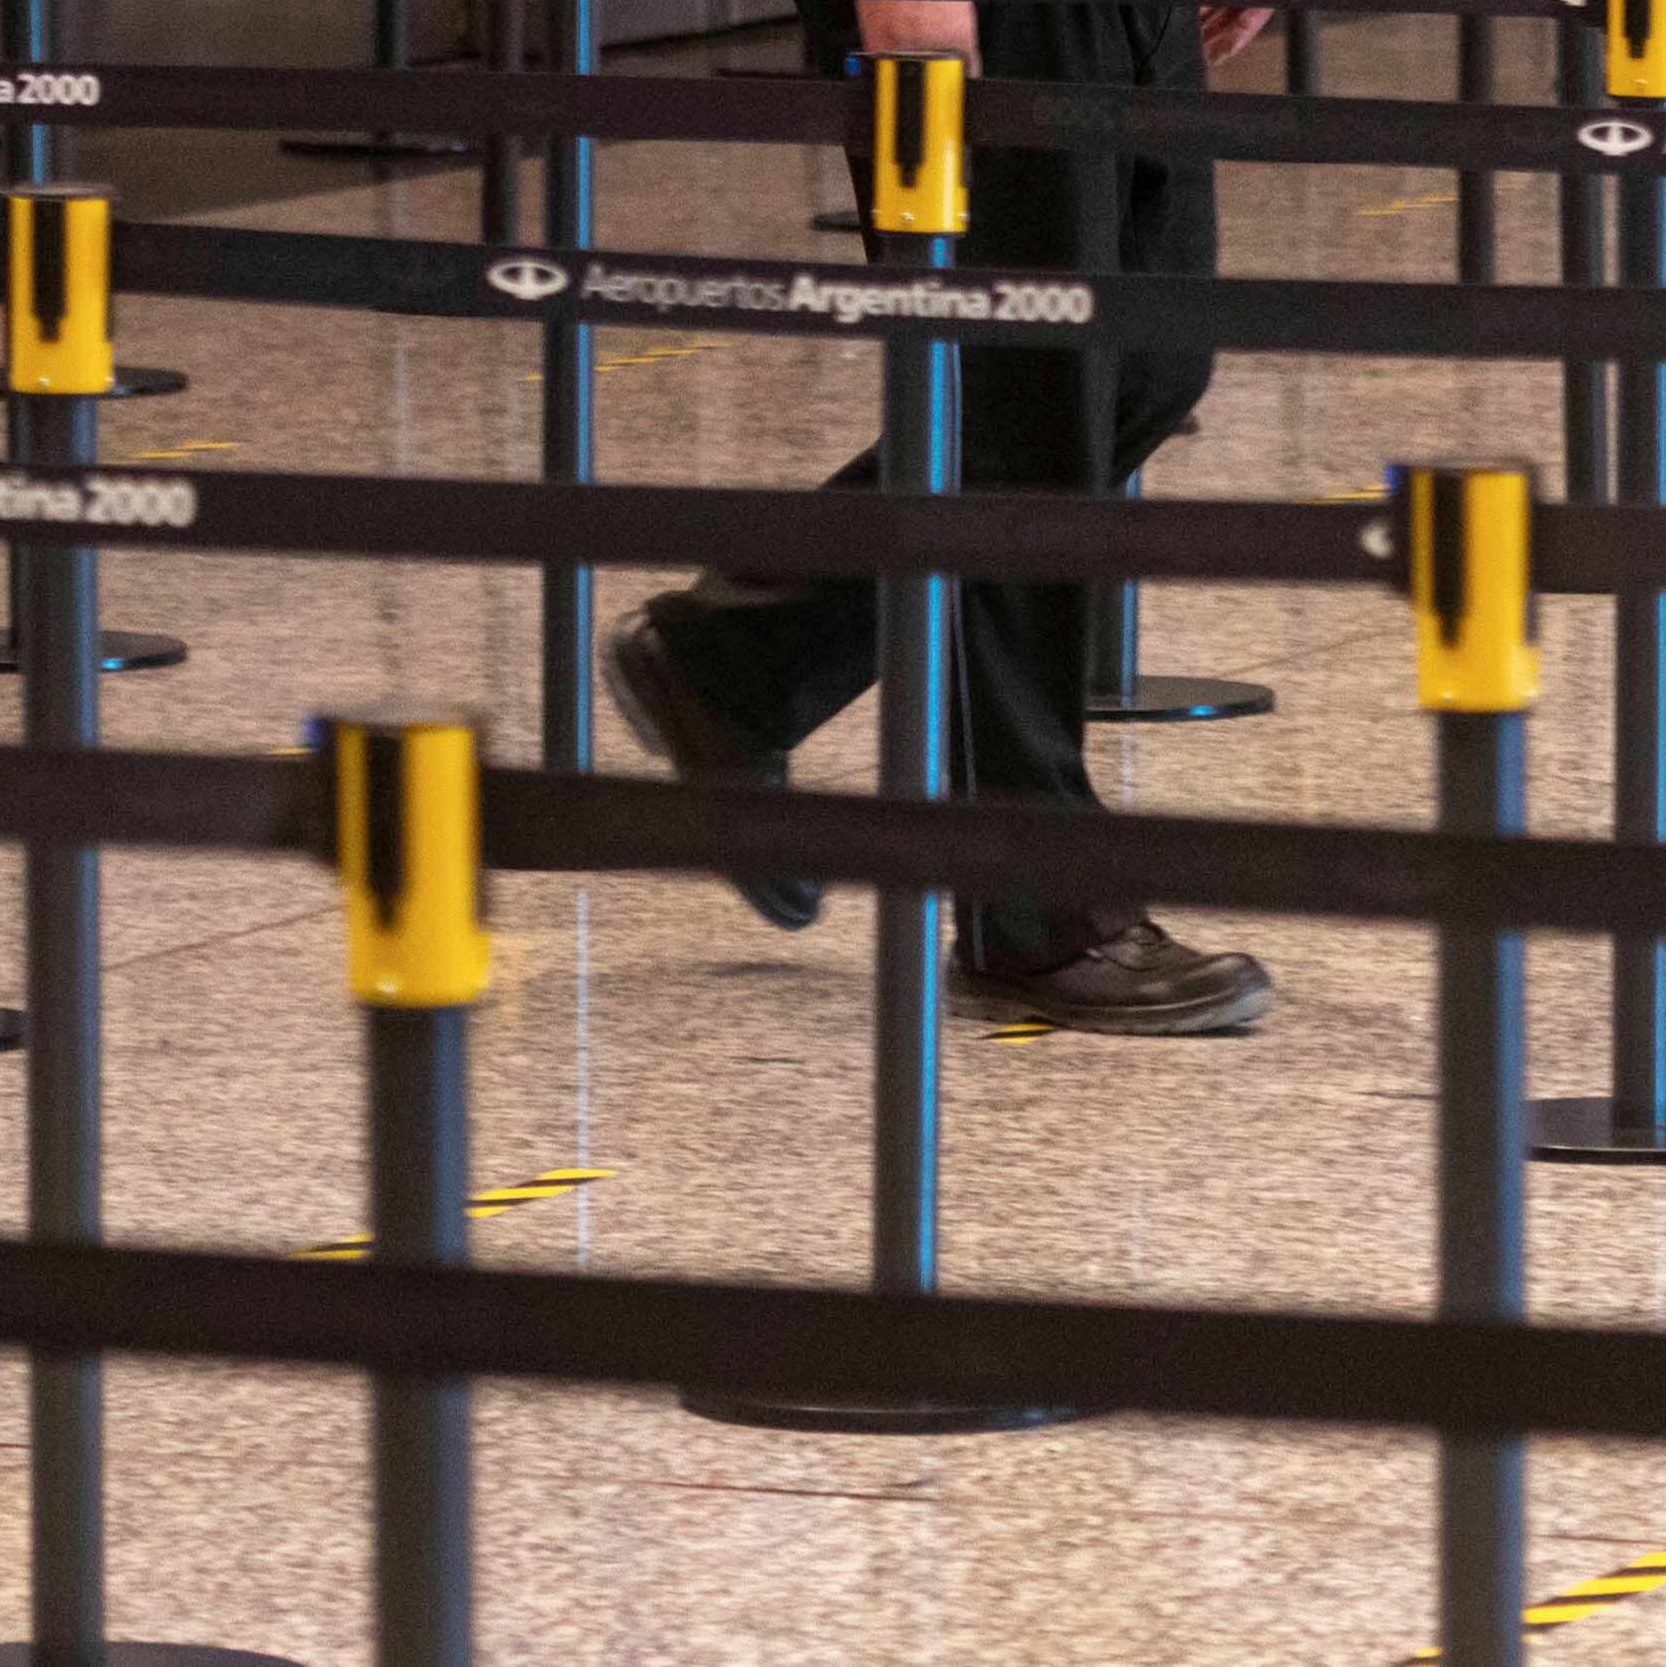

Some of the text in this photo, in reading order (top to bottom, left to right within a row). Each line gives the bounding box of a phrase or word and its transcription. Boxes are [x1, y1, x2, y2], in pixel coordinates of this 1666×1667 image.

[15, 73, 101, 106] 2000
[581, 263, 1095, 324] Aeropuertos Argentina 2000
[85, 475, 198, 526] 2000
